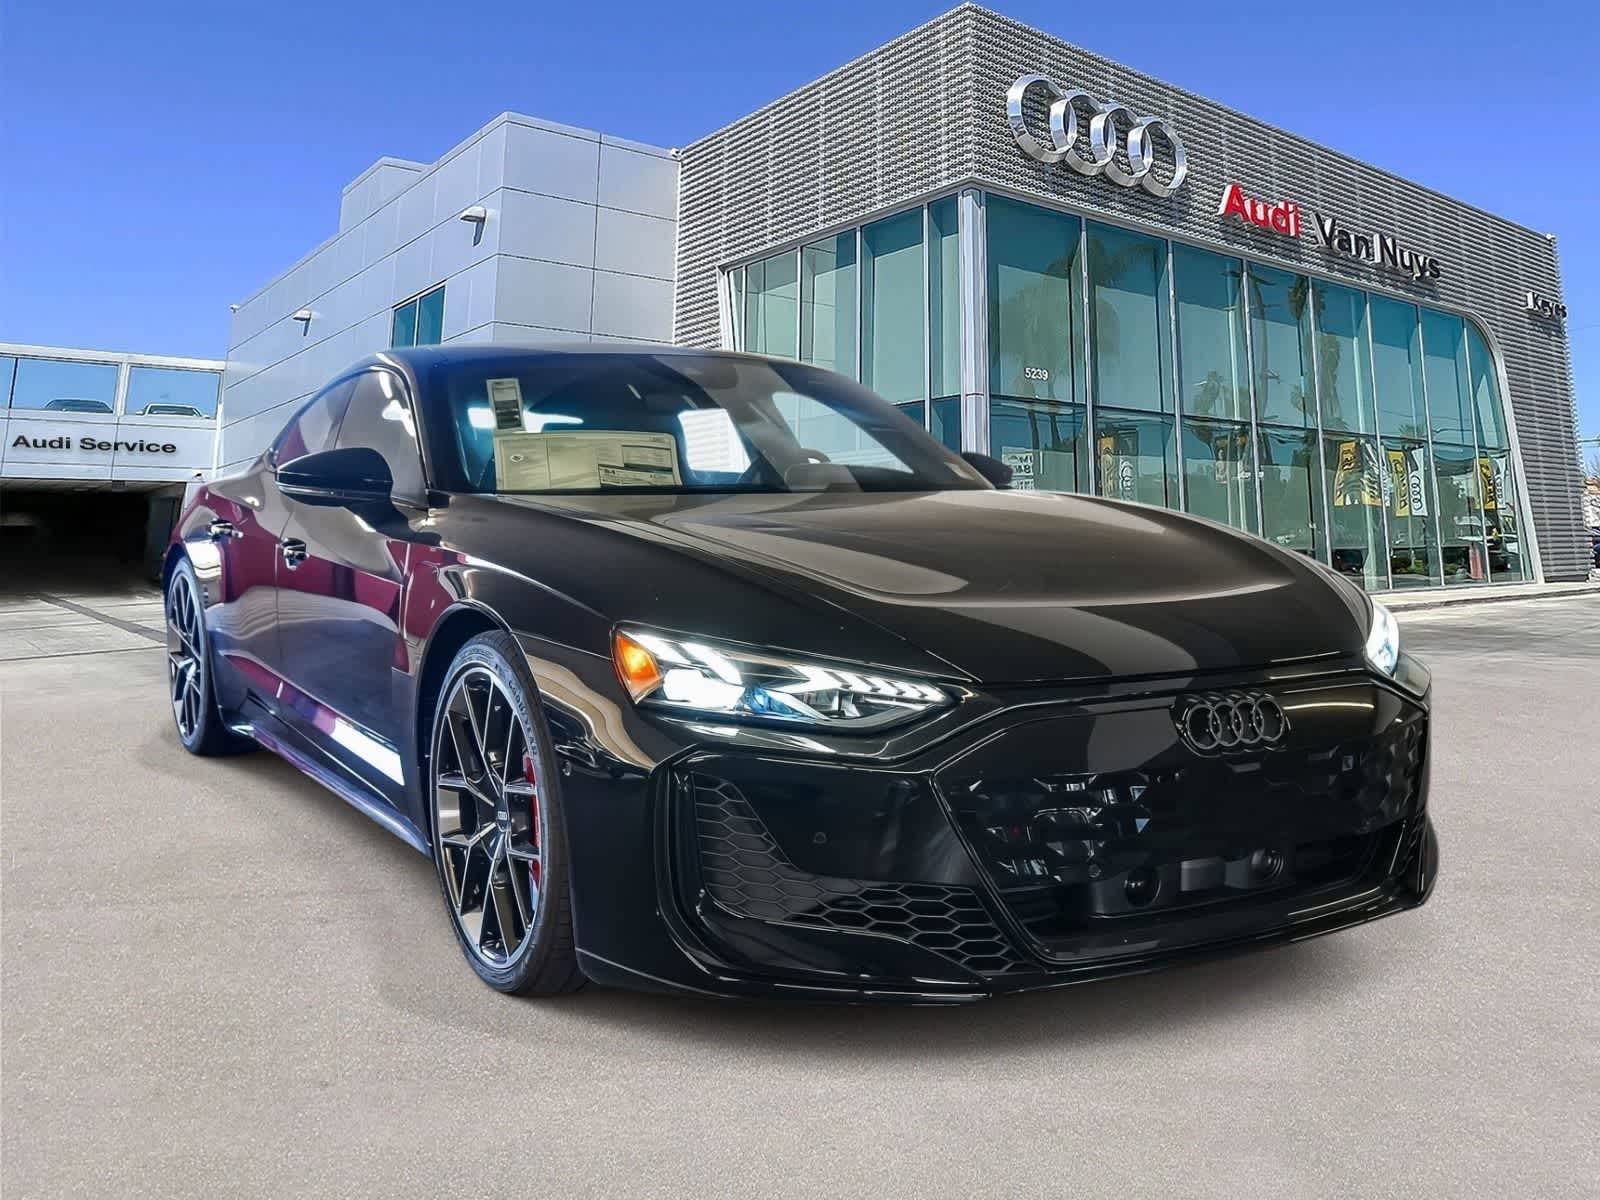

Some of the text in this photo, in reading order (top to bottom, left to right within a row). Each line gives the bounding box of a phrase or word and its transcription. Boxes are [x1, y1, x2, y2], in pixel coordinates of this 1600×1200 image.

[1217, 183, 1440, 280] Audi Van Nuys
[1527, 291, 1567, 318] Keyes
[1025, 367, 1049, 380] 5239
[12, 435, 177, 453] Audi Service
